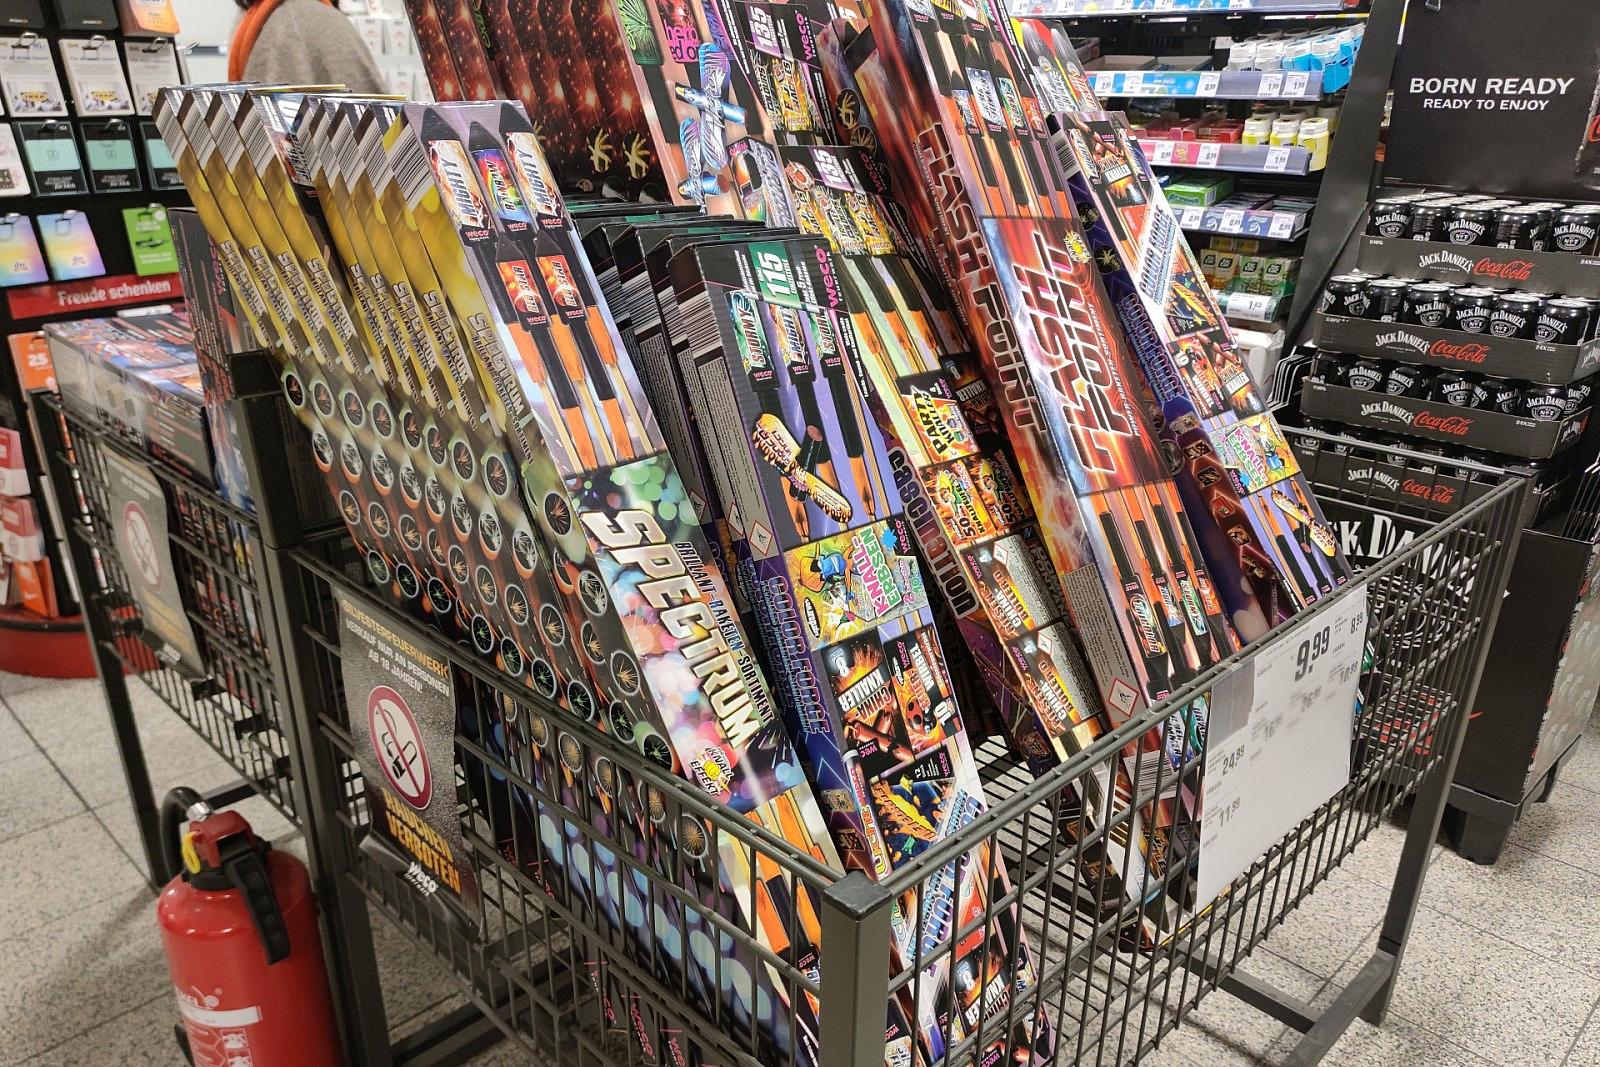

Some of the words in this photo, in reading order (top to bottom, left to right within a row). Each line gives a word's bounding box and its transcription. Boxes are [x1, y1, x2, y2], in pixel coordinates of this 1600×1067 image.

[751, 7, 773, 48] 135
[796, 12, 813, 61] weco
[1409, 78, 1477, 95] BORN
[1485, 78, 1575, 95] READY
[1423, 98, 1472, 109] READY
[1477, 99, 1496, 110] TO
[1499, 99, 1549, 110] ENJOY
[519, 151, 555, 214] MIGHTY
[814, 149, 839, 185] 135
[440, 157, 478, 219] MIGHTY
[465, 230, 490, 239] weco
[507, 223, 527, 231] weco
[1147, 204, 1171, 248] FORCE
[1374, 214, 1391, 226] JACK
[1553, 224, 1569, 237] JACK
[1569, 222, 1596, 240] DANIEL'S
[512, 265, 531, 293] STAR
[551, 260, 569, 288] STAR
[764, 251, 791, 297] 115
[816, 247, 842, 310] weco
[918, 122, 991, 275] FLASH
[971, 283, 1048, 434] POINT
[1139, 247, 1158, 300] COLOR
[1418, 252, 1441, 268] JACK
[1441, 250, 1475, 275] DANIEL'S
[1472, 256, 1535, 281] Coca-Cola
[57, 287, 106, 306] Freude
[110, 280, 171, 299] schenken
[306, 258, 359, 341] SPECTRUM
[523, 291, 540, 314] RED
[563, 285, 579, 308] RED
[1414, 302, 1433, 315] JACK
[392, 282, 438, 372] SPECTRUM
[526, 315, 547, 323] weco
[565, 309, 584, 317] weco
[1456, 308, 1474, 320] JACK
[1500, 310, 1527, 329] DANIEL'S
[422, 290, 469, 385] SPECTRUM
[738, 303, 767, 365] STORMY
[1033, 232, 1142, 438] POINT
[1122, 292, 1161, 352] COLOR
[1147, 346, 1181, 402] FORCE
[1375, 332, 1397, 347] JACK
[1397, 330, 1431, 356] DANIEL'S
[1429, 339, 1491, 364] Coca-Cola
[28, 353, 48, 367] 25
[468, 312, 526, 417] SPECTRUM
[753, 370, 773, 379] weco
[1012, 262, 1117, 474] FLASH
[1174, 349, 1189, 366] 10
[1358, 365, 1383, 382] DANIEL'S
[1441, 382, 1460, 395] JACK
[1526, 397, 1545, 408] JACK
[911, 386, 948, 455] PARTY
[1360, 403, 1381, 416] JACK
[1382, 401, 1415, 427] DANIEL'S
[1413, 410, 1474, 437] Coca-Cola
[1227, 434, 1265, 487] ERBSEN
[1234, 426, 1267, 483] KNALL-
[1347, 469, 1368, 481] JACK
[954, 479, 985, 534] KNALLTEUFEL
[895, 520, 908, 554] weco
[959, 514, 977, 538] 50
[852, 537, 890, 616] KNALL-
[859, 527, 902, 605] ERBSEN
[902, 594, 916, 605] 2
[993, 587, 1022, 629] CHINA-
[341, 599, 450, 680] SILVESTERFEUERWERK
[580, 509, 762, 752] SPECTRUM
[674, 541, 776, 725] BRILLANT-RAKETEN-SORTIMENT
[345, 618, 378, 650] VERKAUF
[377, 640, 391, 660] NUR
[407, 657, 450, 698] PERSONEN
[367, 649, 379, 665] AB
[380, 657, 390, 672] 18
[390, 664, 424, 695] JAHREN!
[768, 575, 807, 656] COLOR
[795, 657, 830, 735] FORCE
[836, 656, 849, 678] 8
[911, 643, 936, 692] WIRBEL
[1295, 626, 1331, 682] 9.99
[837, 669, 885, 712] KNALLER
[856, 686, 893, 722] CHINA-
[1039, 680, 1068, 721] CHINA-
[935, 704, 952, 726] 10
[860, 744, 878, 758] wec
[1222, 744, 1245, 776] 24.99
[690, 759, 721, 798] EFFEKT
[383, 788, 454, 865] RAUCHEN
[385, 811, 463, 896] VERBOTEN
[408, 860, 439, 894] weco
[962, 969, 975, 990] 8
